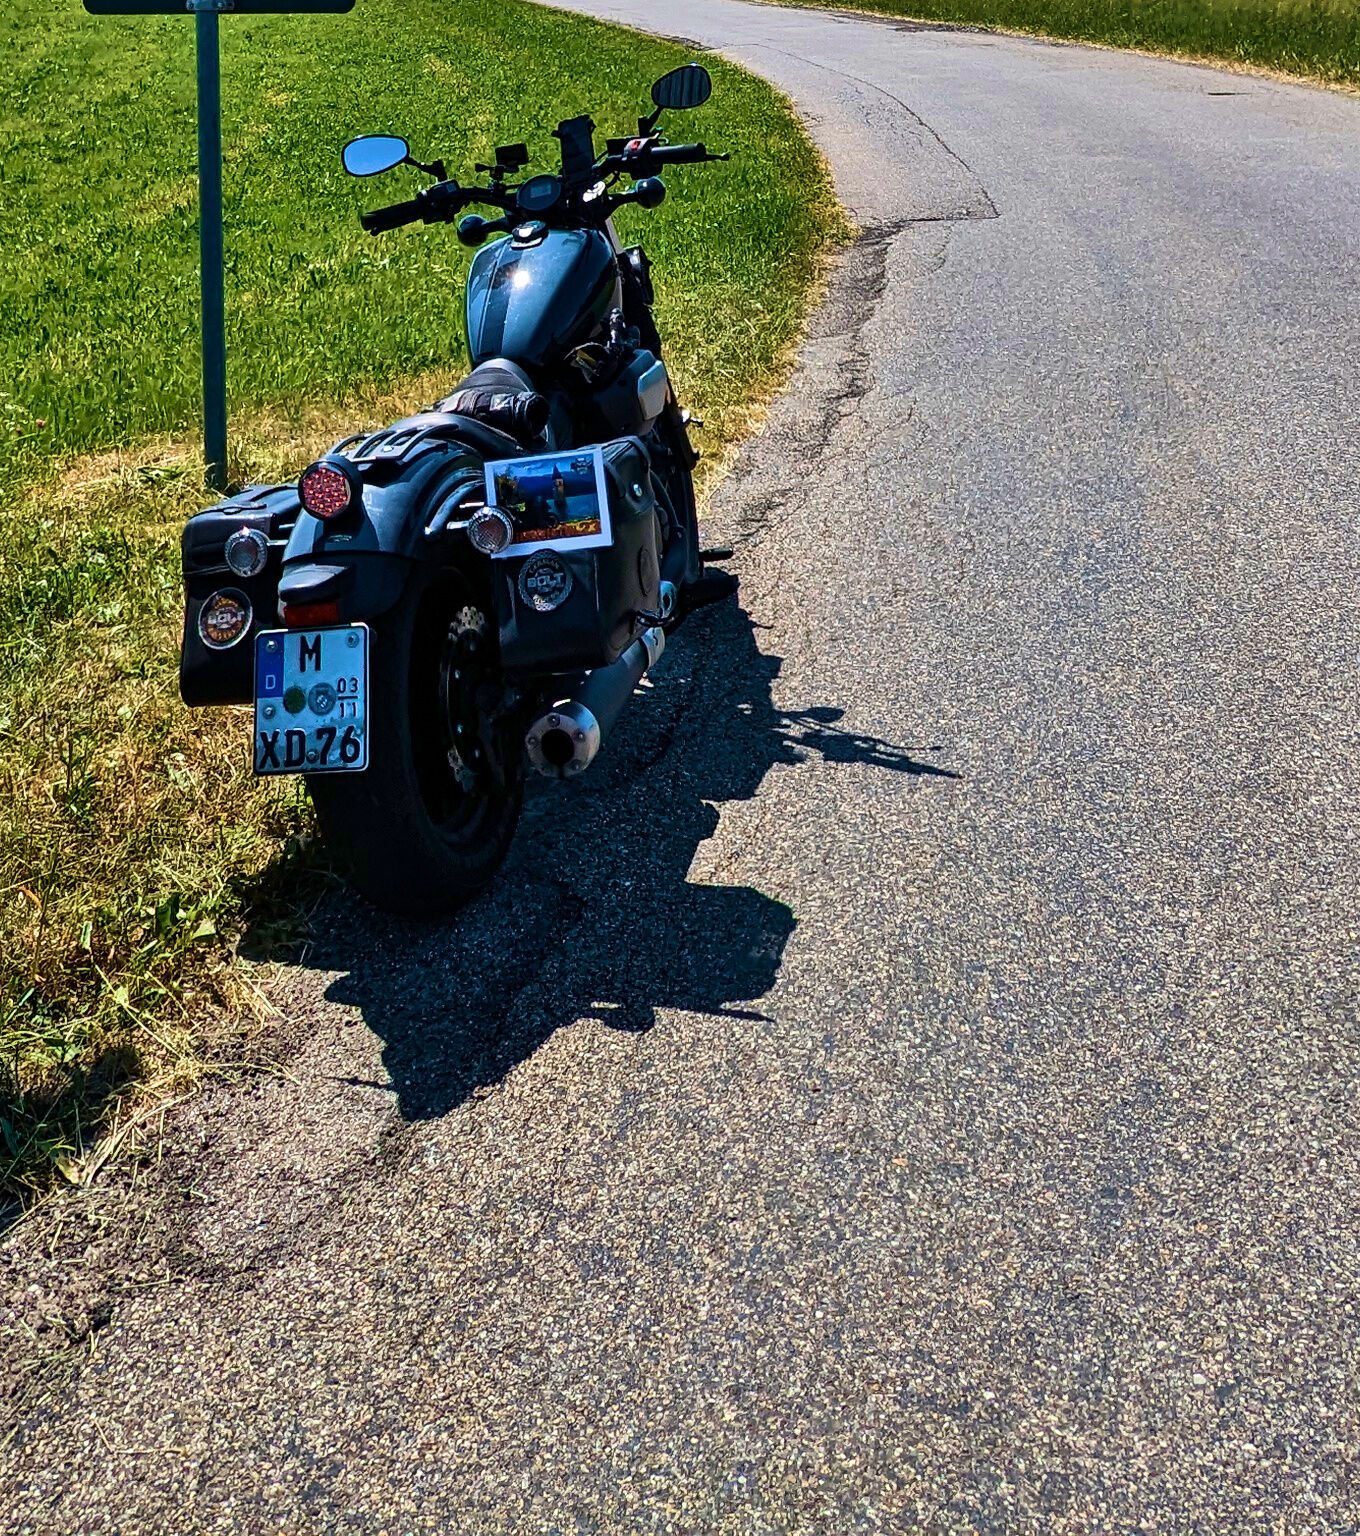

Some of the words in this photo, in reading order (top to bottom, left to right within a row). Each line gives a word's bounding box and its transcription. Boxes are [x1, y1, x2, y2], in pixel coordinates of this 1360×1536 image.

[300, 634, 321, 672] M
[266, 675, 276, 689] D
[337, 677, 358, 693] 03
[340, 702, 356, 718] 11
[259, 729, 306, 769] XD
[316, 725, 360, 765] 76
